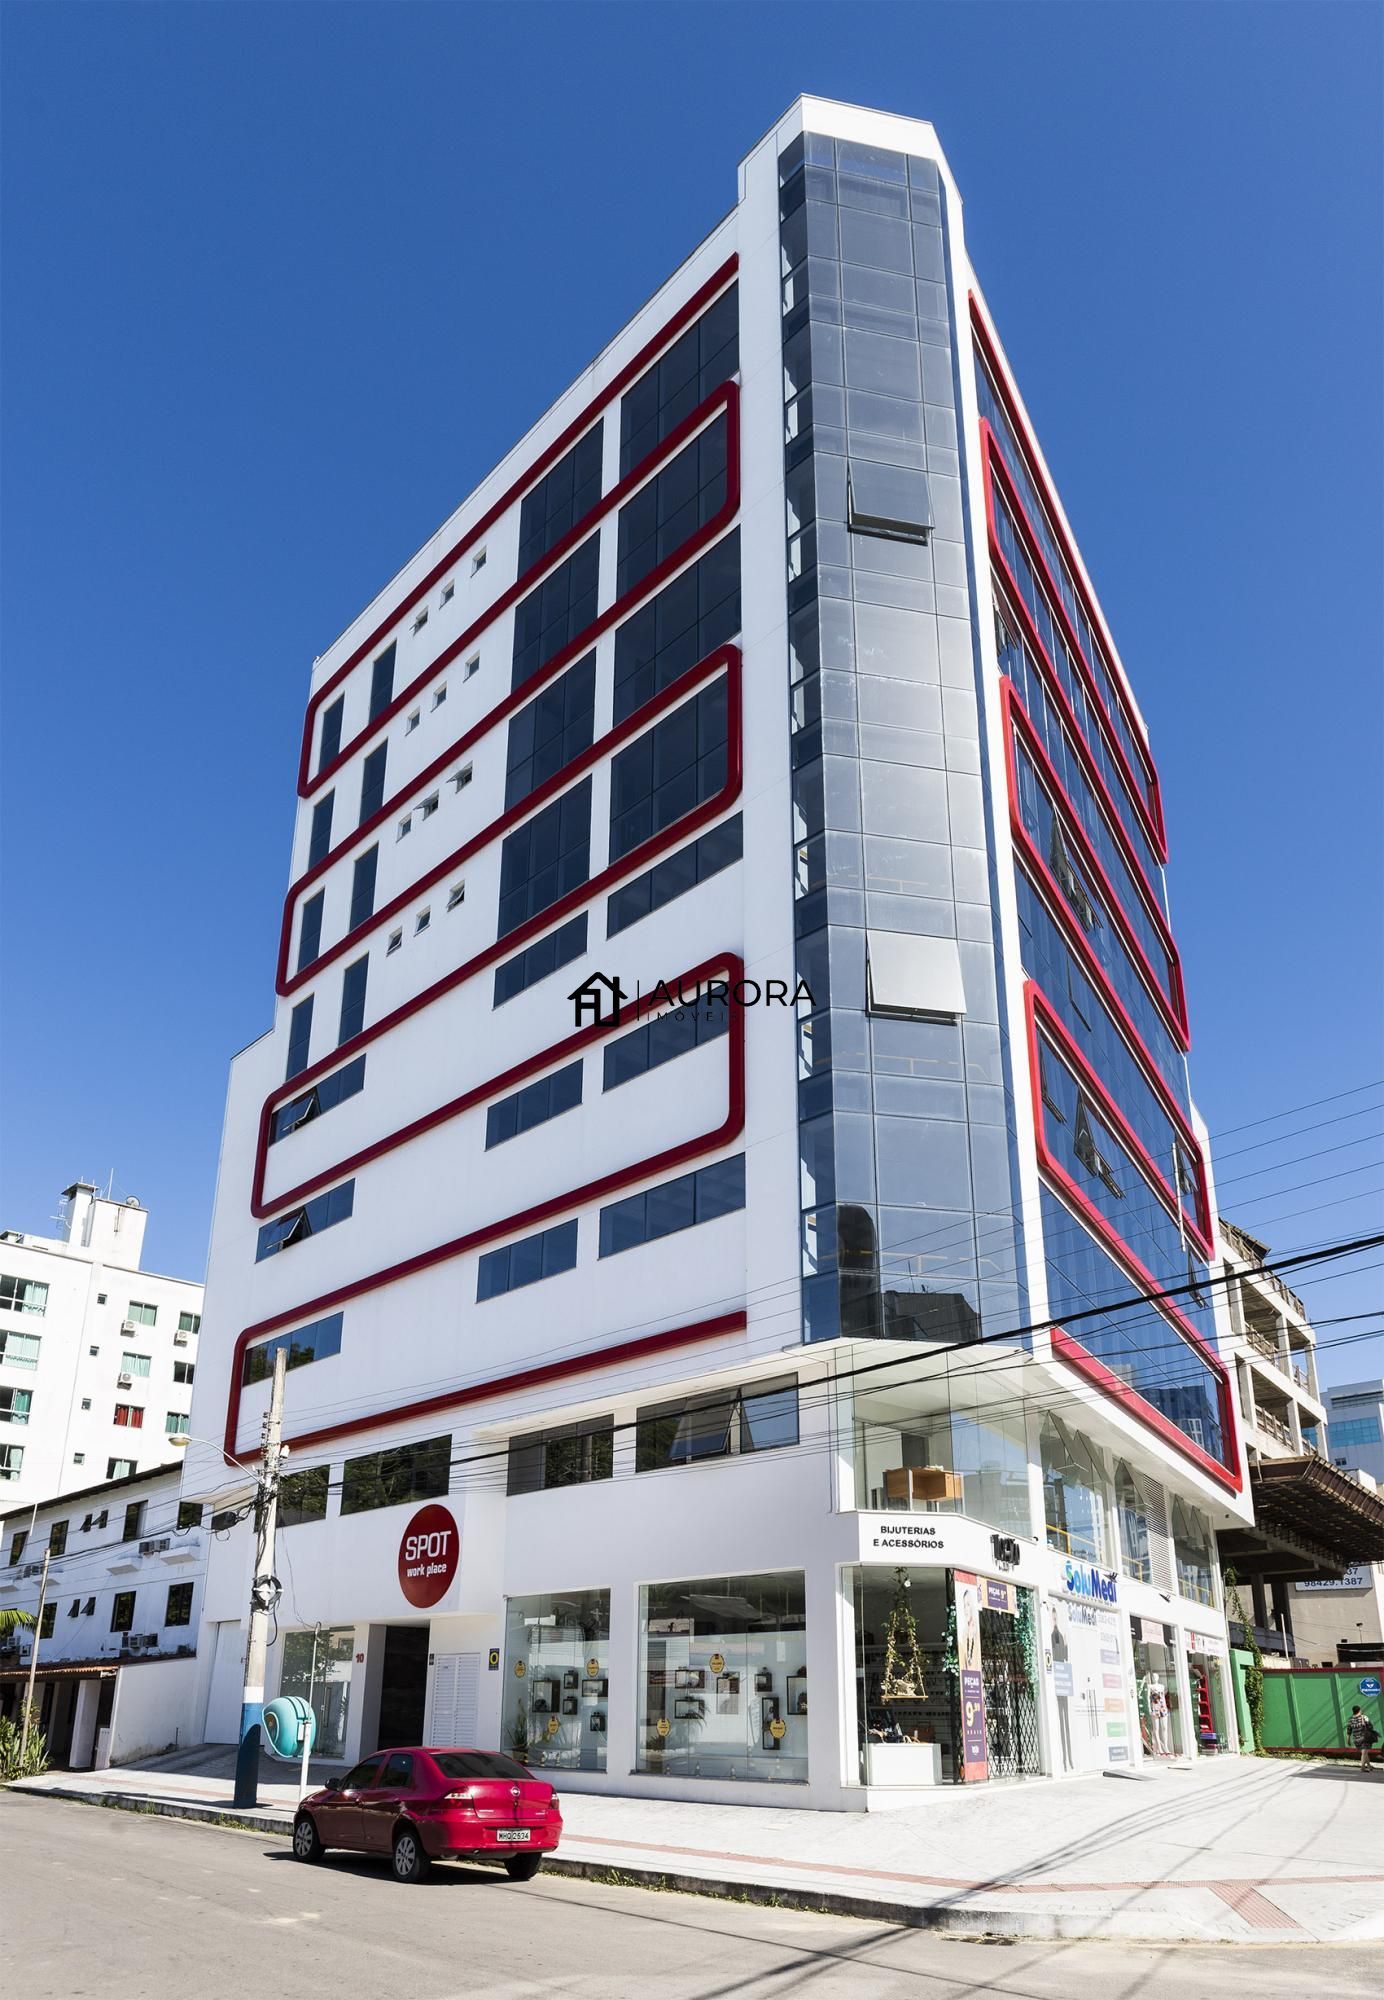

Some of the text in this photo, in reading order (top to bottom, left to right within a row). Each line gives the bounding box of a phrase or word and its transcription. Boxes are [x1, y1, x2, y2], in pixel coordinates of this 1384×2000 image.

[880, 1525, 936, 1536] BIJUTERIAS
[405, 1530, 452, 1561] SPOT
[873, 1538, 945, 1549] E ACESSÓRIOS
[406, 1562, 448, 1578] work place
[355, 1653, 365, 1664] 10
